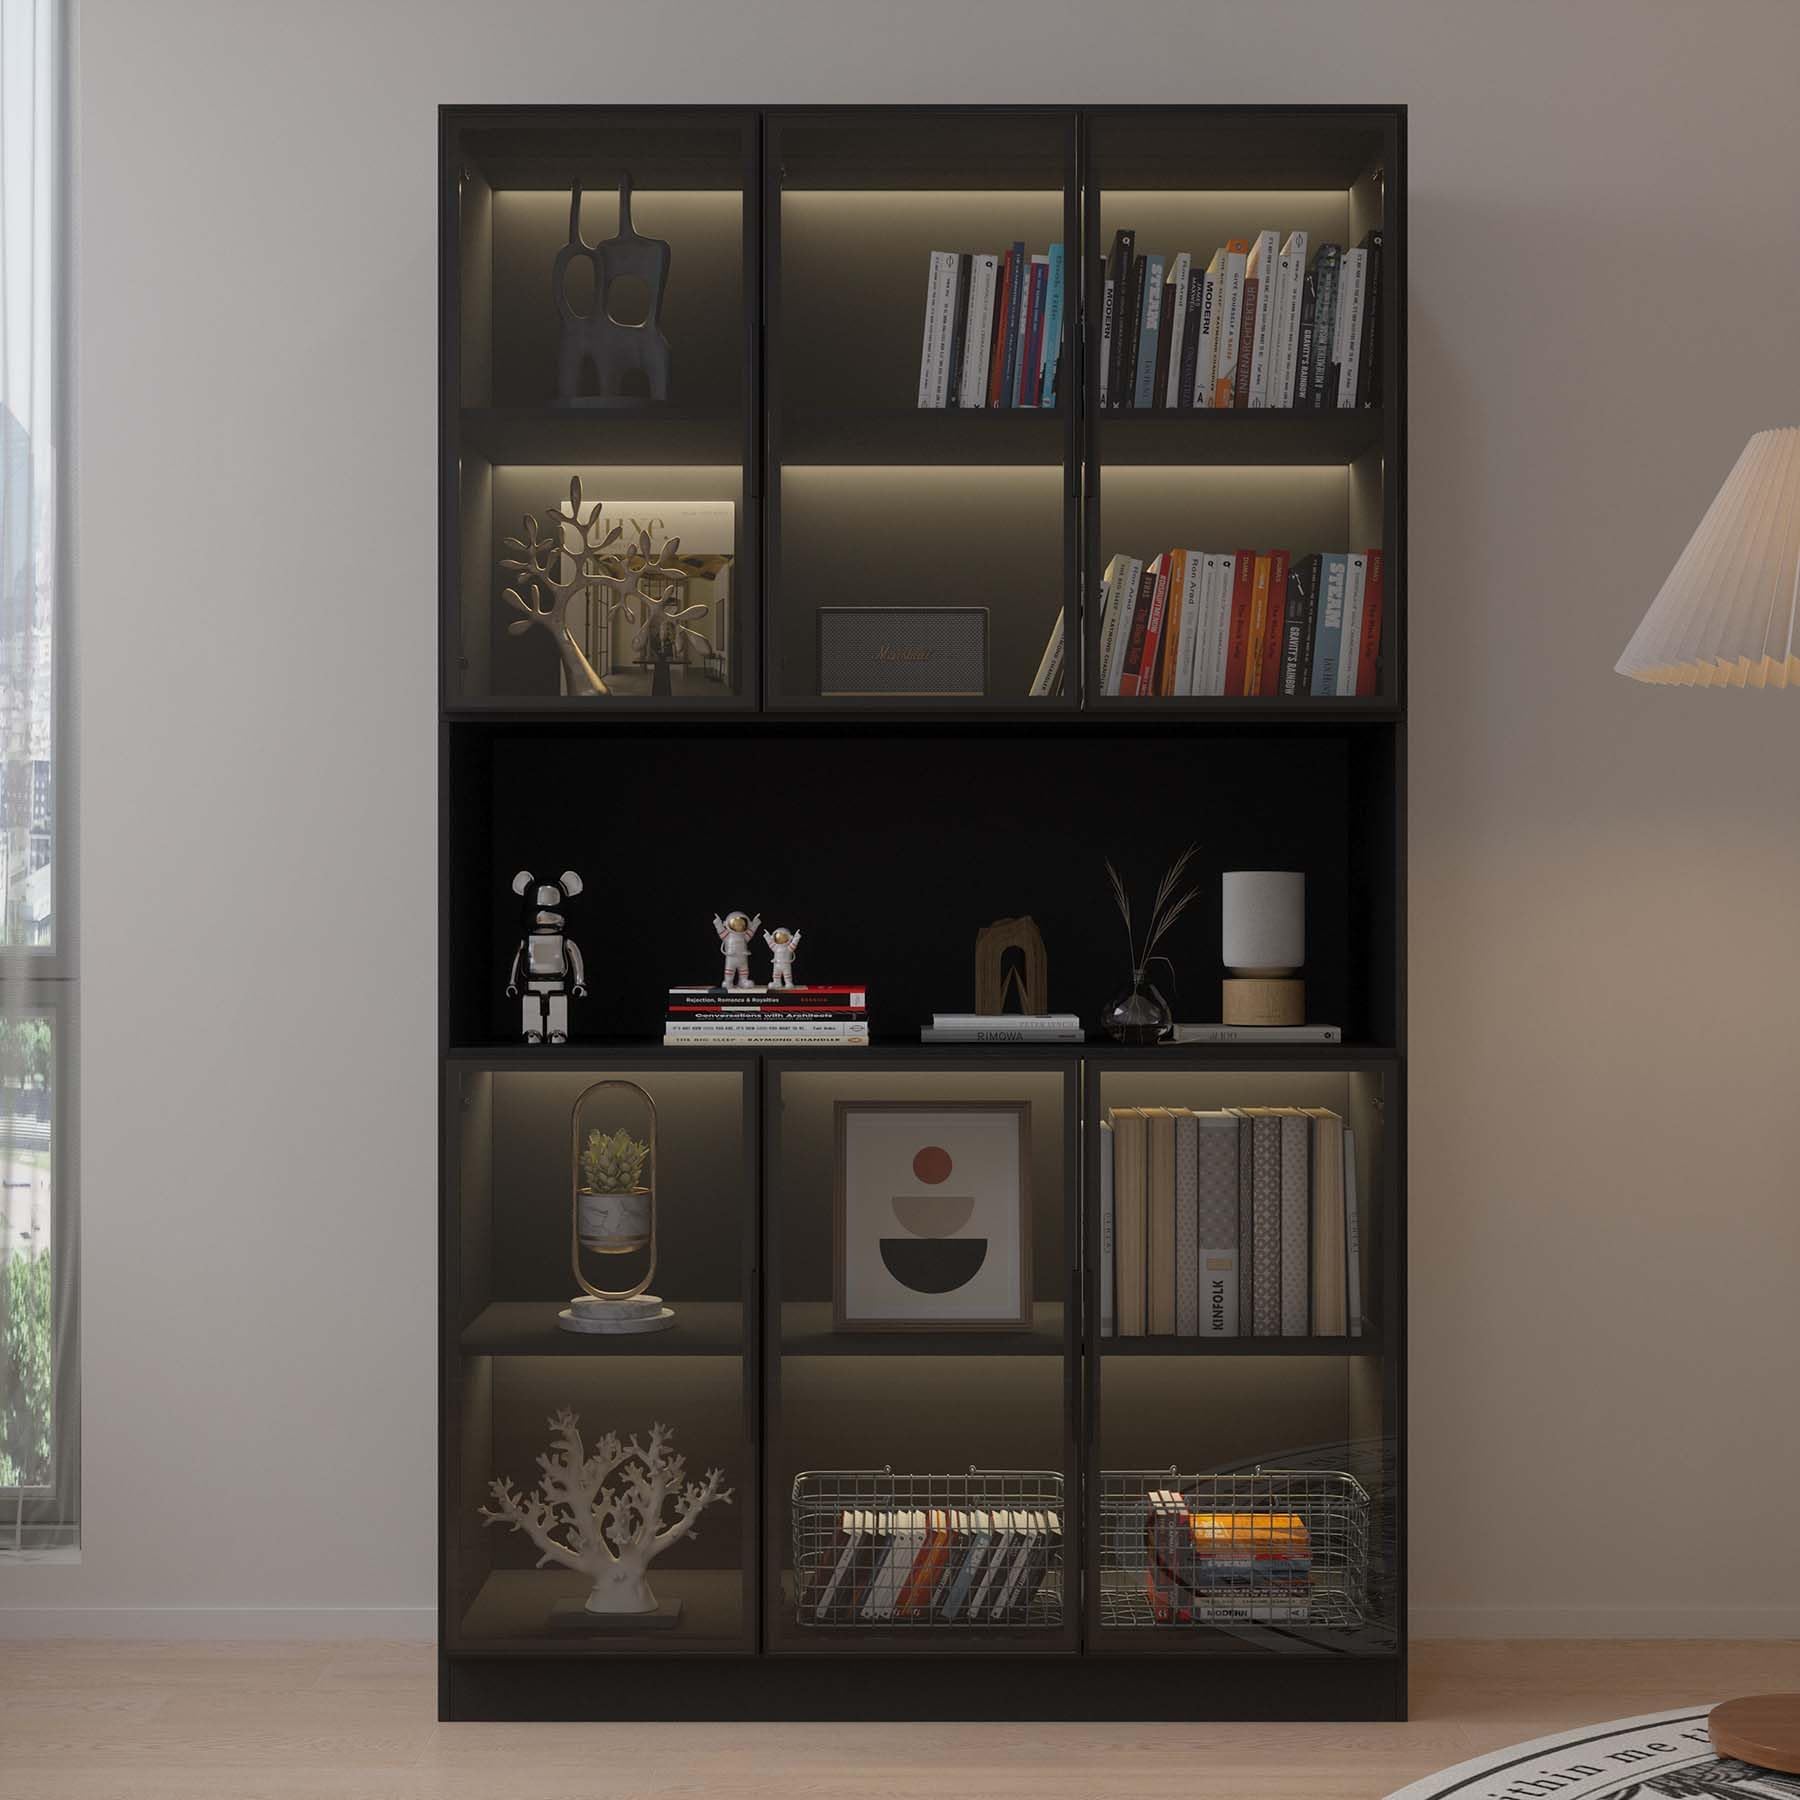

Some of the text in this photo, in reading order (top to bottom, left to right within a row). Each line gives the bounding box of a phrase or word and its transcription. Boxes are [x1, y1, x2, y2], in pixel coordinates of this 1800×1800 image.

[1189, 277, 1197, 312] MAXWELL
[1232, 273, 1240, 289] GIVE
[1104, 289, 1113, 339] MODERN
[1203, 281, 1214, 335] MODERN
[1230, 293, 1238, 329] YOURSELF
[1240, 288, 1257, 393] INNENARCHITEKTUR
[1298, 330, 1312, 399] GRAVITY'S RAINBOW
[1191, 559, 1199, 578] Ron
[1188, 581, 1197, 605] Arad
[1325, 563, 1345, 628] STEAM
[1106, 618, 1116, 653] RAYMOND
[1287, 626, 1300, 662] GRAVITY'S
[1099, 654, 1110, 689] CHANDLER
[1284, 663, 1297, 696] RAINBOW
[977, 1031, 1024, 1041] RIMOWA
[1211, 1280, 1224, 1331] KINFOLK
[1604, 1743, 1678, 1763] me
